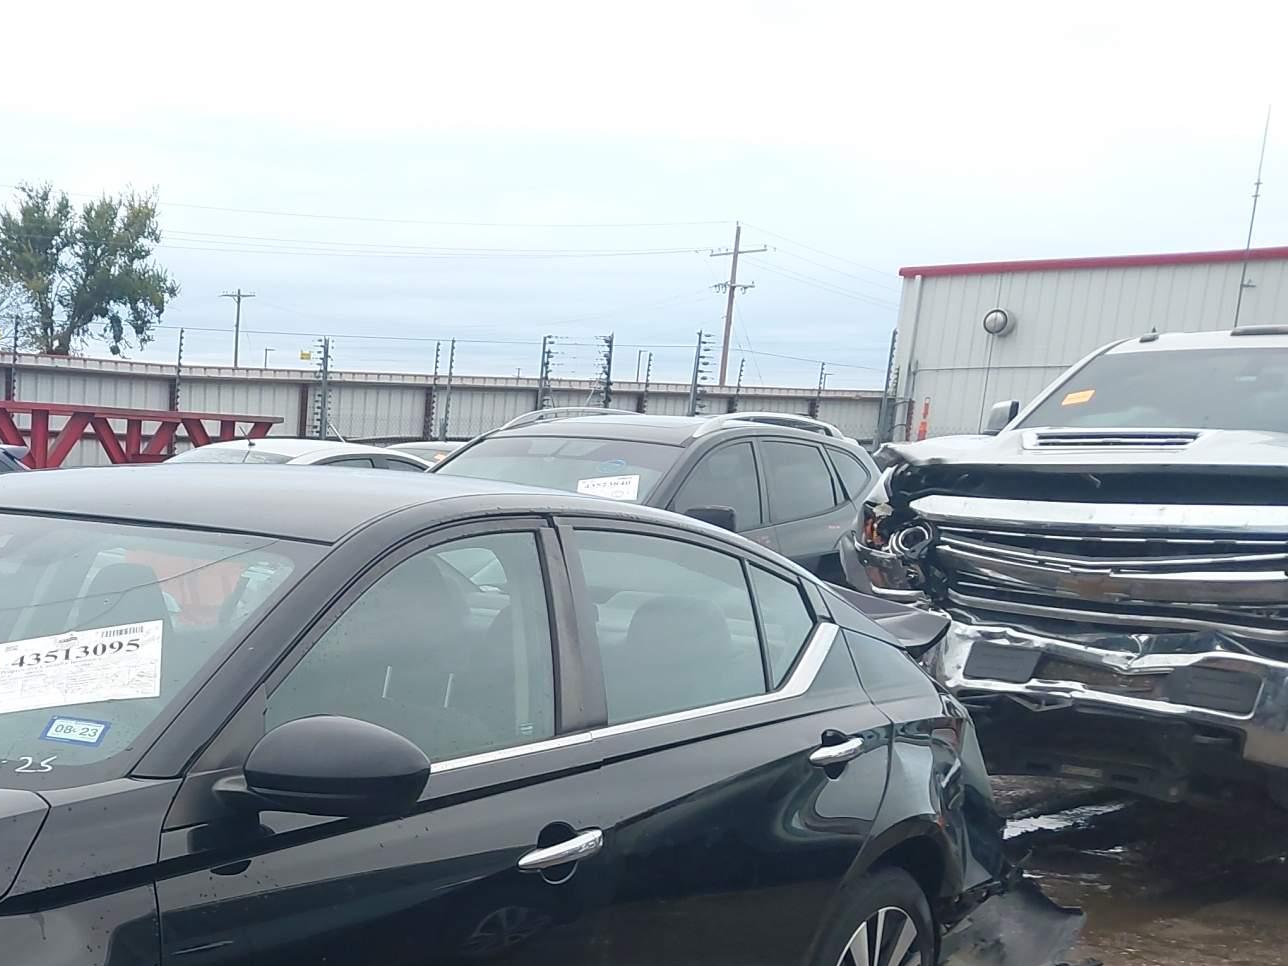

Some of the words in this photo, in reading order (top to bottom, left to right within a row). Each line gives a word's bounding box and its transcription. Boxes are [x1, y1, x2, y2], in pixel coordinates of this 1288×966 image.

[12, 639, 140, 667] 43513095
[54, 724, 73, 734] 08
[78, 727, 99, 738] 23
